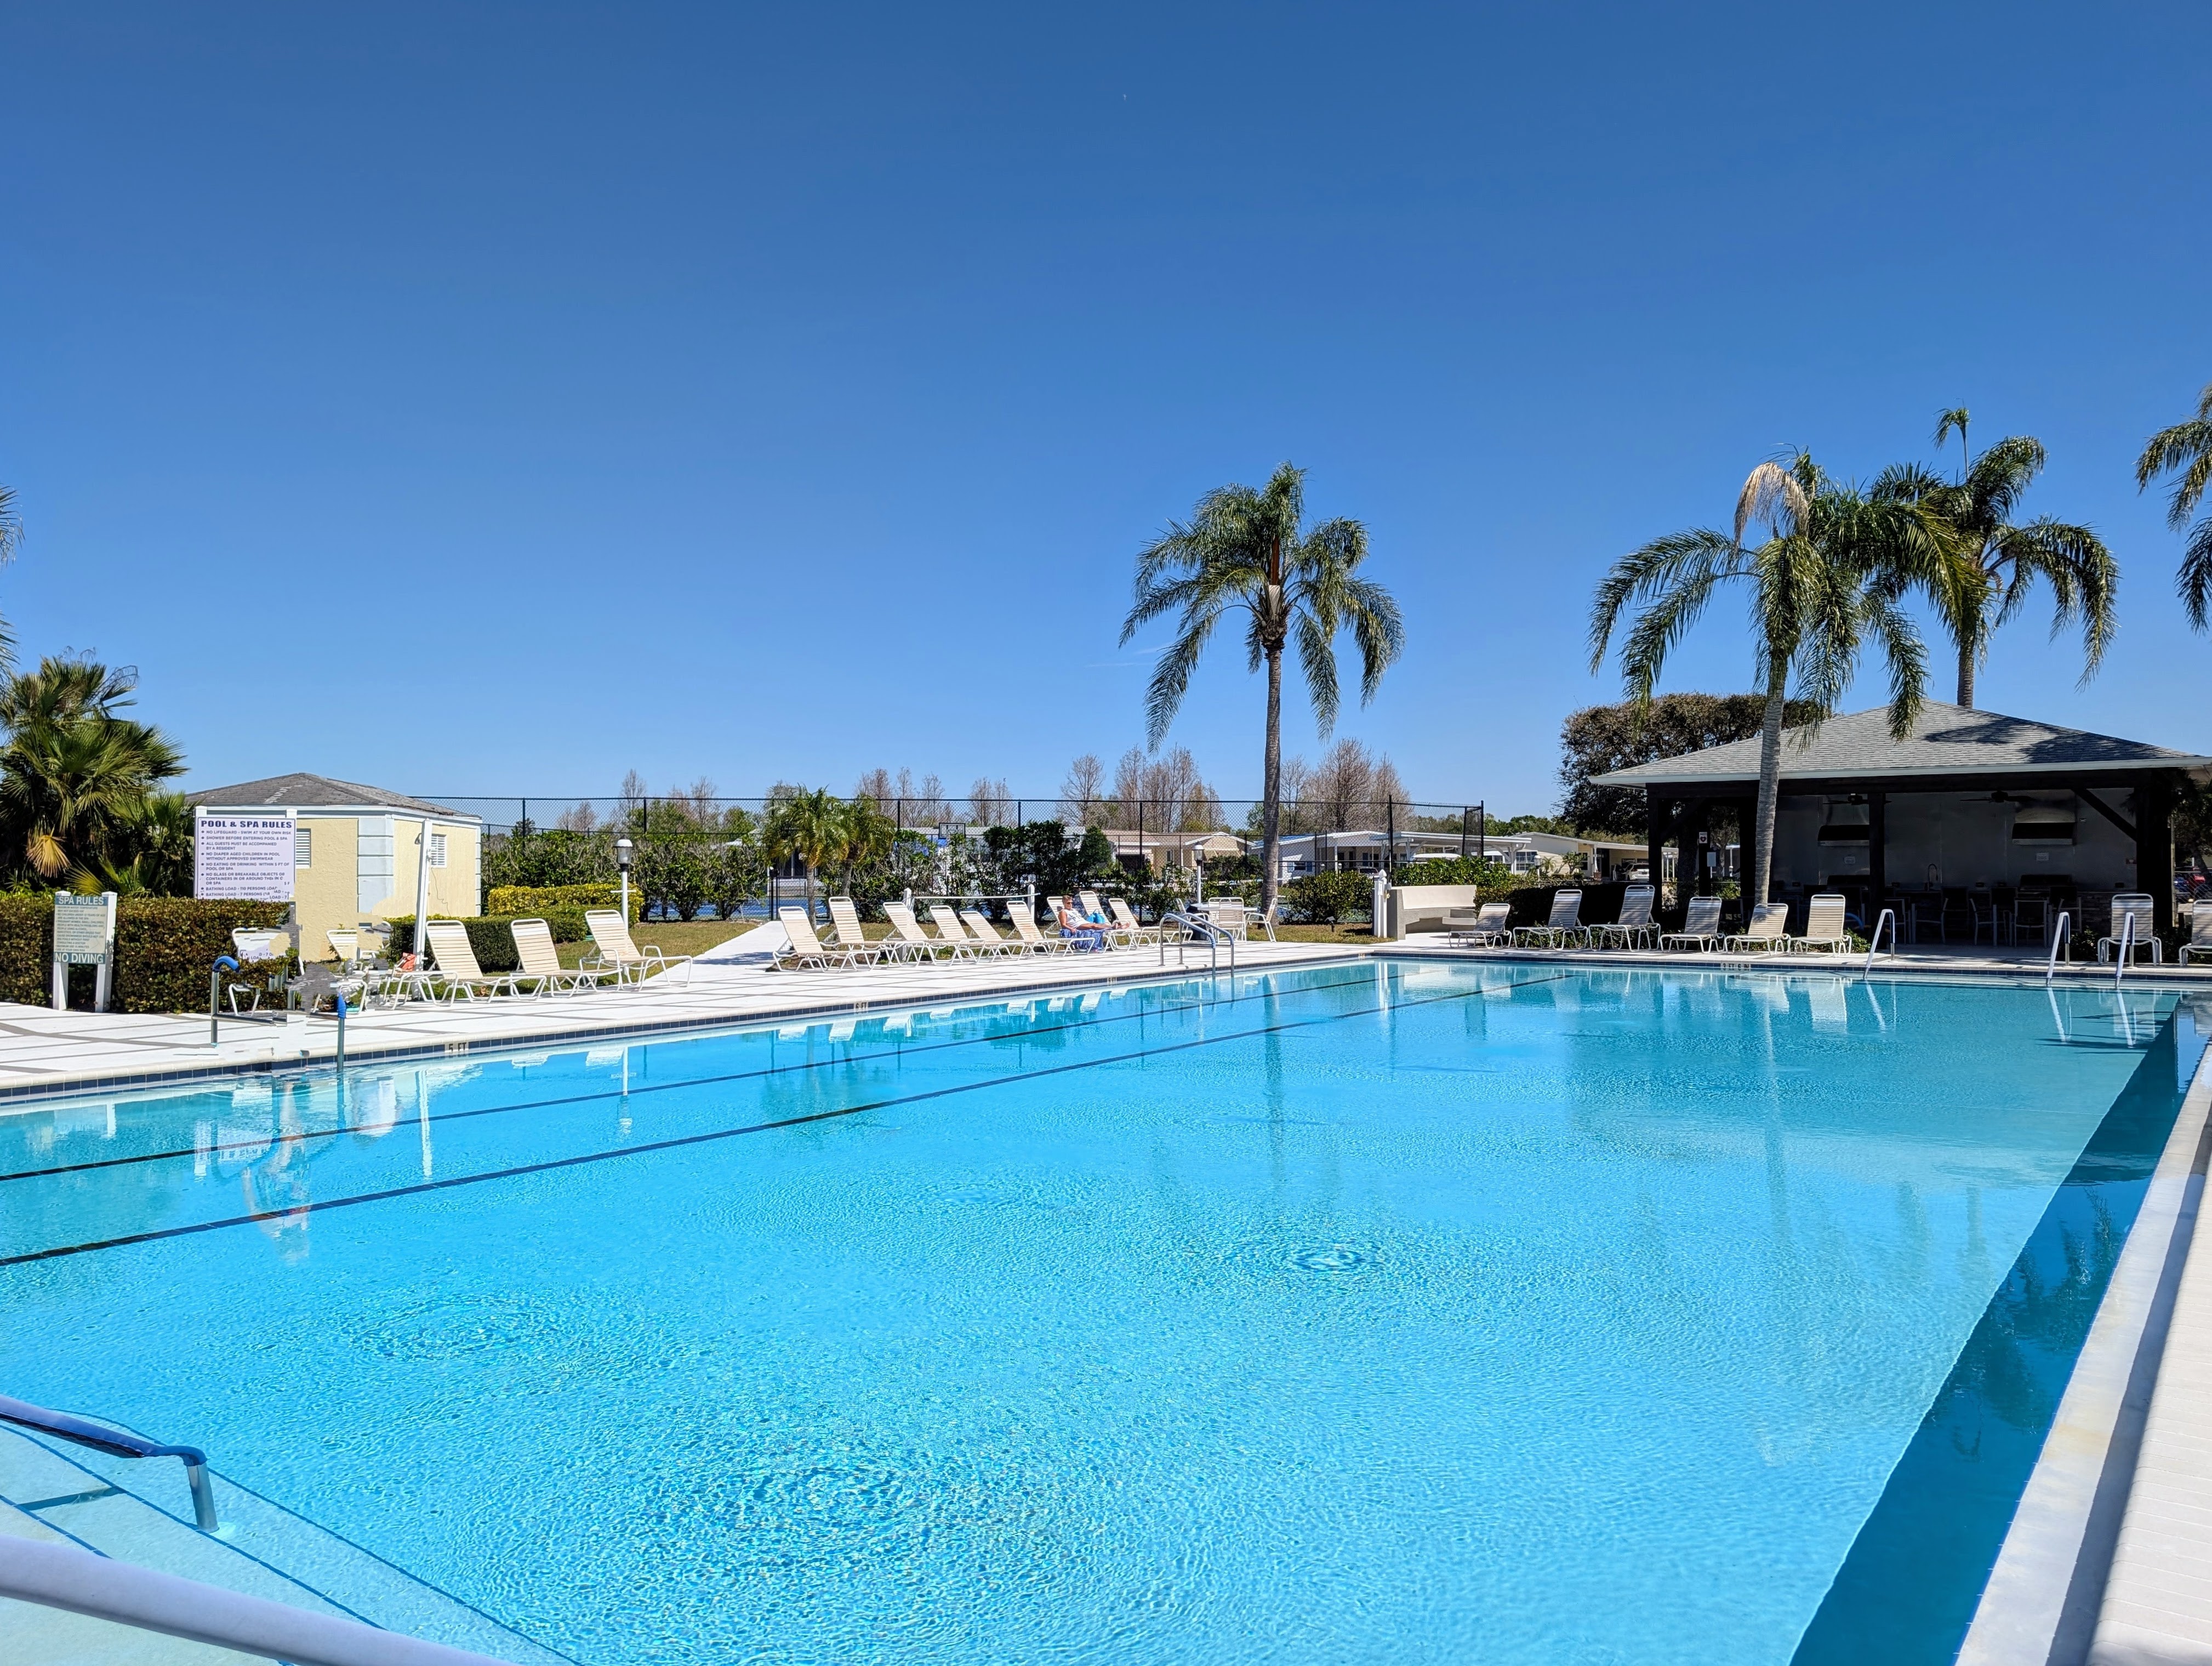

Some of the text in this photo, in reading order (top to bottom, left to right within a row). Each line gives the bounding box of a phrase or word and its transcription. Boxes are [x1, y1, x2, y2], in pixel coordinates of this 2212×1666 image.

[59, 896, 104, 905] SPA RULES
[55, 952, 104, 964] NO DIVING
[448, 1042, 466, 1052] 5 FT
